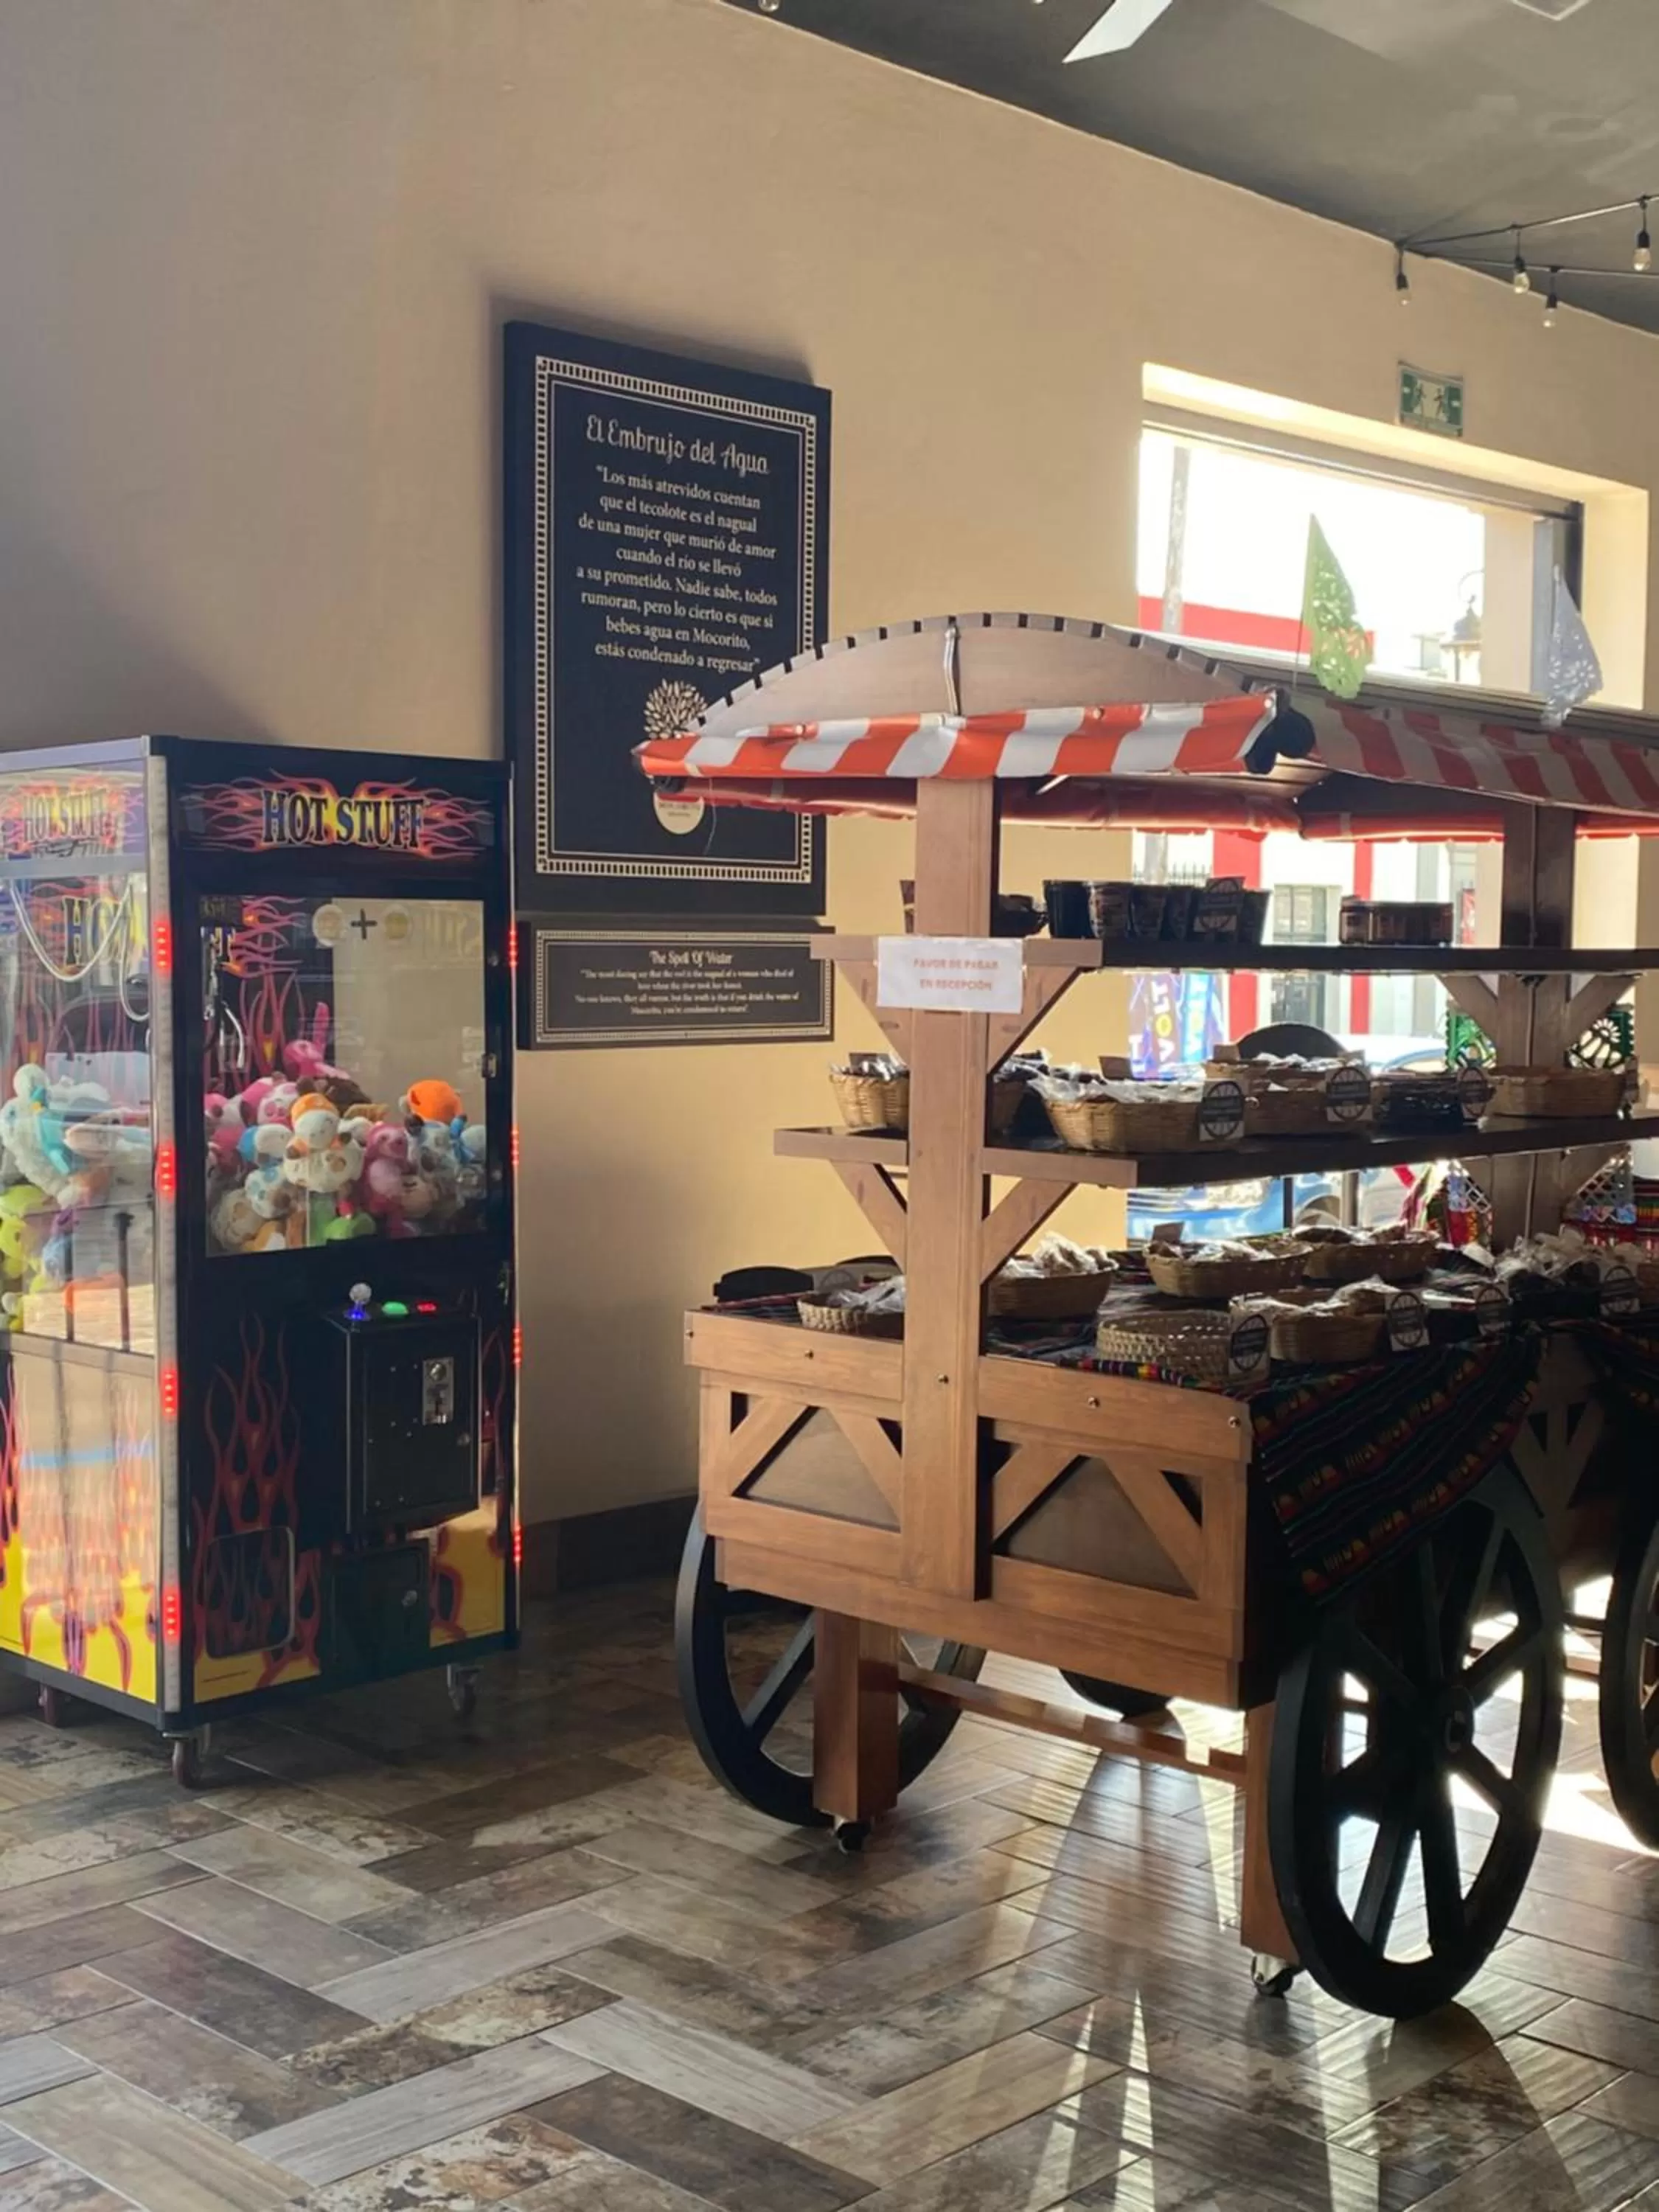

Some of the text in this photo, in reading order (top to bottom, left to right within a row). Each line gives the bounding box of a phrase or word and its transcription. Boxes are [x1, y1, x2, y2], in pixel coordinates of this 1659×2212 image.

[587, 414, 770, 478] El Embrujo del Agua
[627, 473, 653, 491] más
[655, 480, 712, 501] atrevidos
[713, 491, 761, 510] cuentan
[599, 495, 757, 535] que el tecolote es el nagual
[578, 512, 777, 560] de una mujer que murió de amor
[616, 547, 663, 566] cuando
[664, 551, 676, 568] el
[698, 560, 712, 573] se
[712, 558, 742, 578] llevó
[577, 566, 585, 579] a
[586, 567, 602, 581] su
[603, 570, 672, 591] prometido.
[675, 577, 712, 597] Nadie
[745, 588, 779, 606] todos
[581, 591, 641, 613] rumoran,
[643, 600, 672, 617] pero
[674, 599, 687, 617] lo
[688, 603, 724, 623] cierto
[725, 611, 738, 625] es
[739, 613, 763, 630] que
[605, 614, 751, 652] bebes agua en Mocorito,
[594, 641, 626, 658] estás
[627, 645, 695, 666] condenado
[696, 655, 705, 667] a
[24, 796, 55, 842] HOT
[262, 789, 425, 849] HOT STUFF
[914, 958, 946, 970] FAVOR
[948, 958, 962, 969] DE
[919, 978, 933, 990] EN
